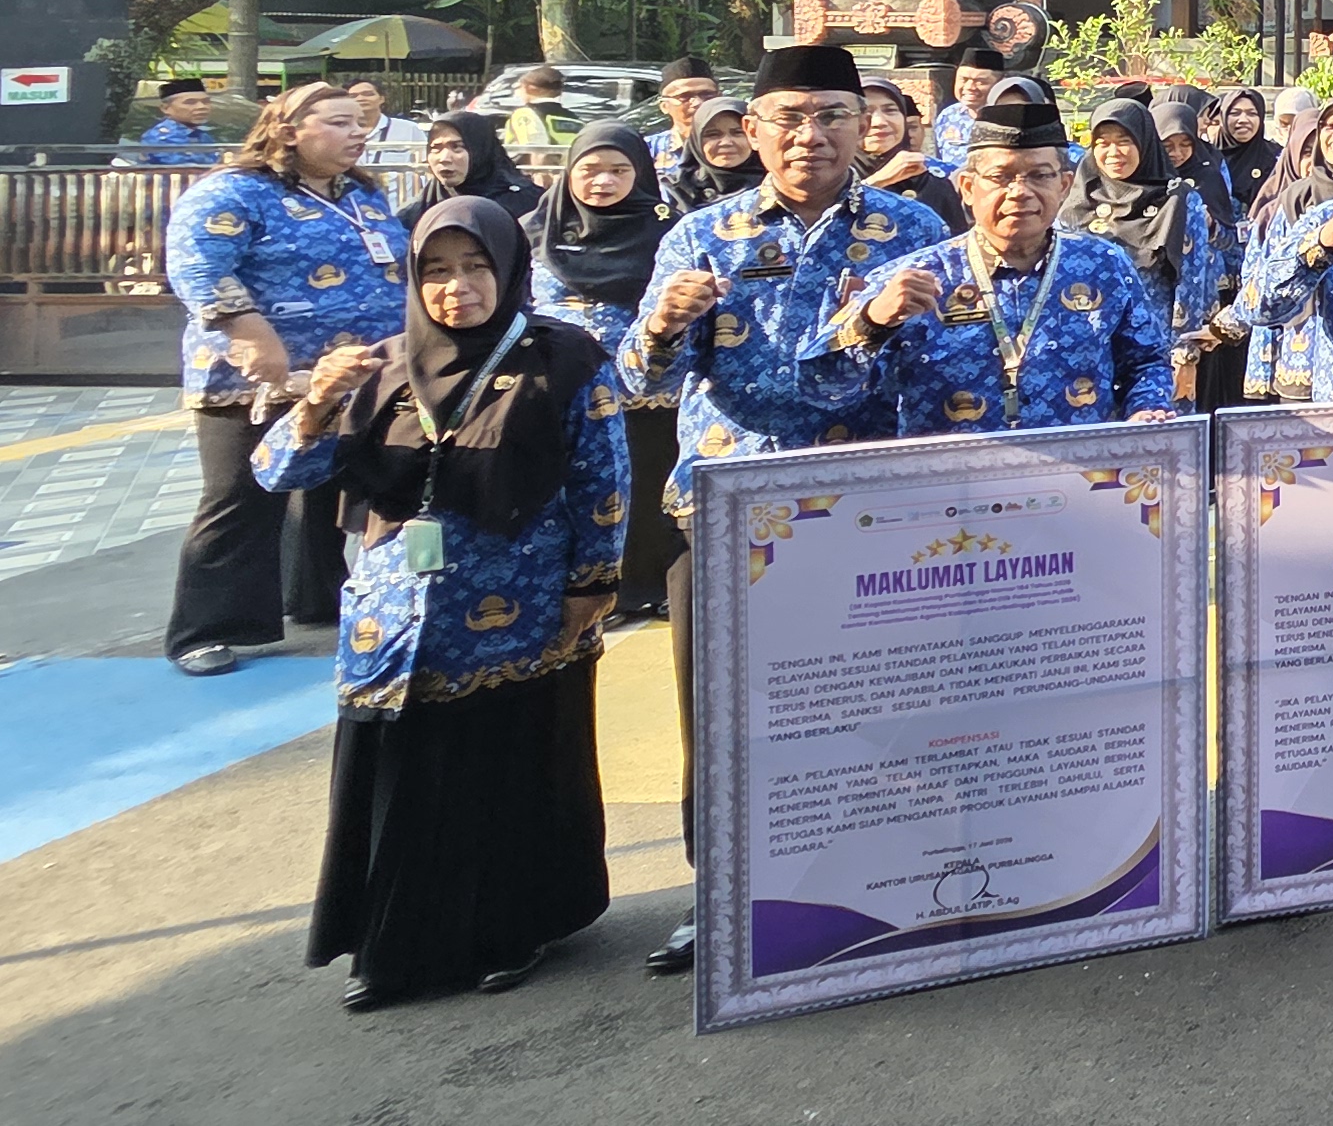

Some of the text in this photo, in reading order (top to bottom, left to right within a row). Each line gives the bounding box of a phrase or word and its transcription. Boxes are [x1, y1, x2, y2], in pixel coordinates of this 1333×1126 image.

[8, 90, 58, 101] MASUK
[855, 551, 1074, 598] MAKLUMAT LAYANAN
[851, 648, 883, 661] KAMI
[887, 638, 964, 656] MENYATAKAN
[968, 630, 1024, 647] SANGGUP
[1028, 615, 1146, 639] MENYELENGGARAKAN
[1274, 643, 1327, 656] MENERIMA
[767, 668, 838, 686] PELAYANAN
[840, 662, 881, 677] SESUAI
[883, 655, 937, 672] STANDAR
[939, 647, 1005, 664] PELAYANAN
[1007, 642, 1039, 655] YANG
[1041, 638, 1076, 651] TELAH
[1274, 658, 1302, 669] YANG
[928, 730, 1000, 749] KOMPENSASI
[866, 876, 906, 890] KANTOR
[988, 852, 1053, 870] PURBALINGGA
[928, 905, 964, 918] ABDUL
